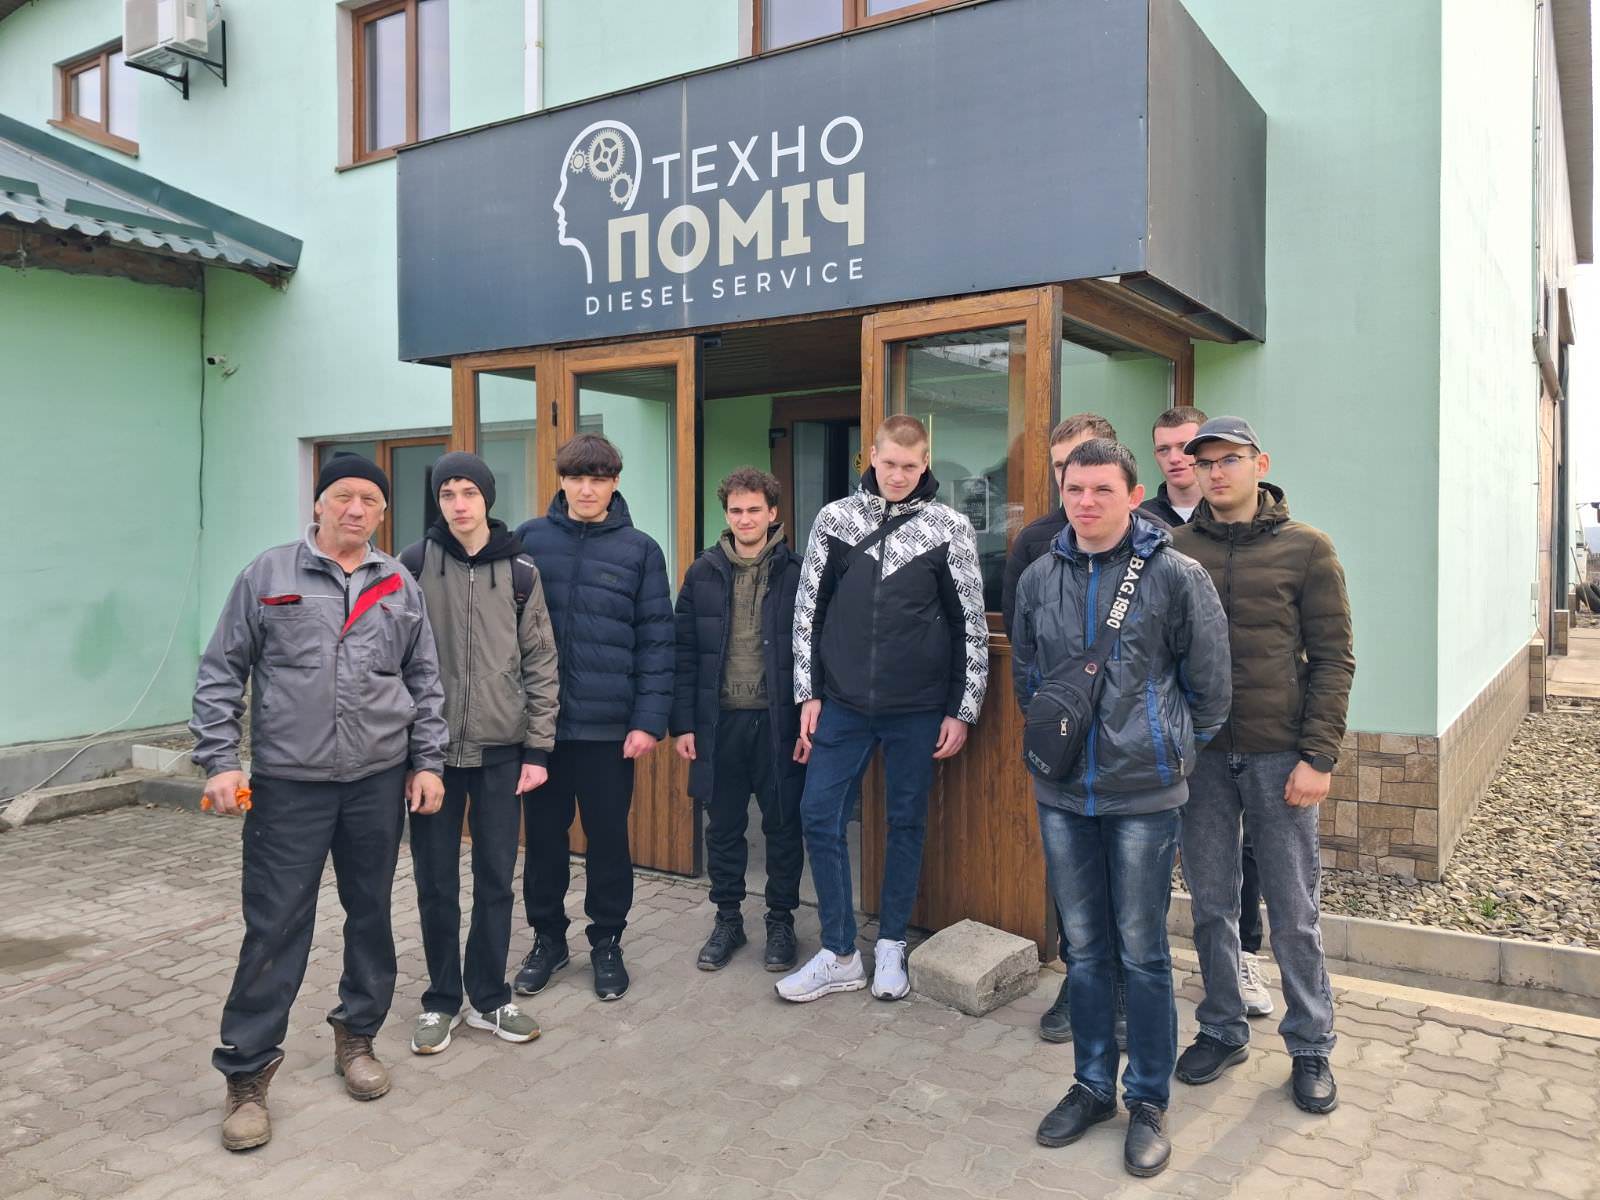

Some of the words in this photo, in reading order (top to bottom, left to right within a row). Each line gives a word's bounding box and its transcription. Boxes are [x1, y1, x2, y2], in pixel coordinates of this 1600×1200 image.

[652, 116, 864, 199] ТЕХНО
[607, 171, 865, 283] ПОМІЧ
[585, 284, 694, 315] DIESEL
[712, 257, 864, 299] SERVICE
